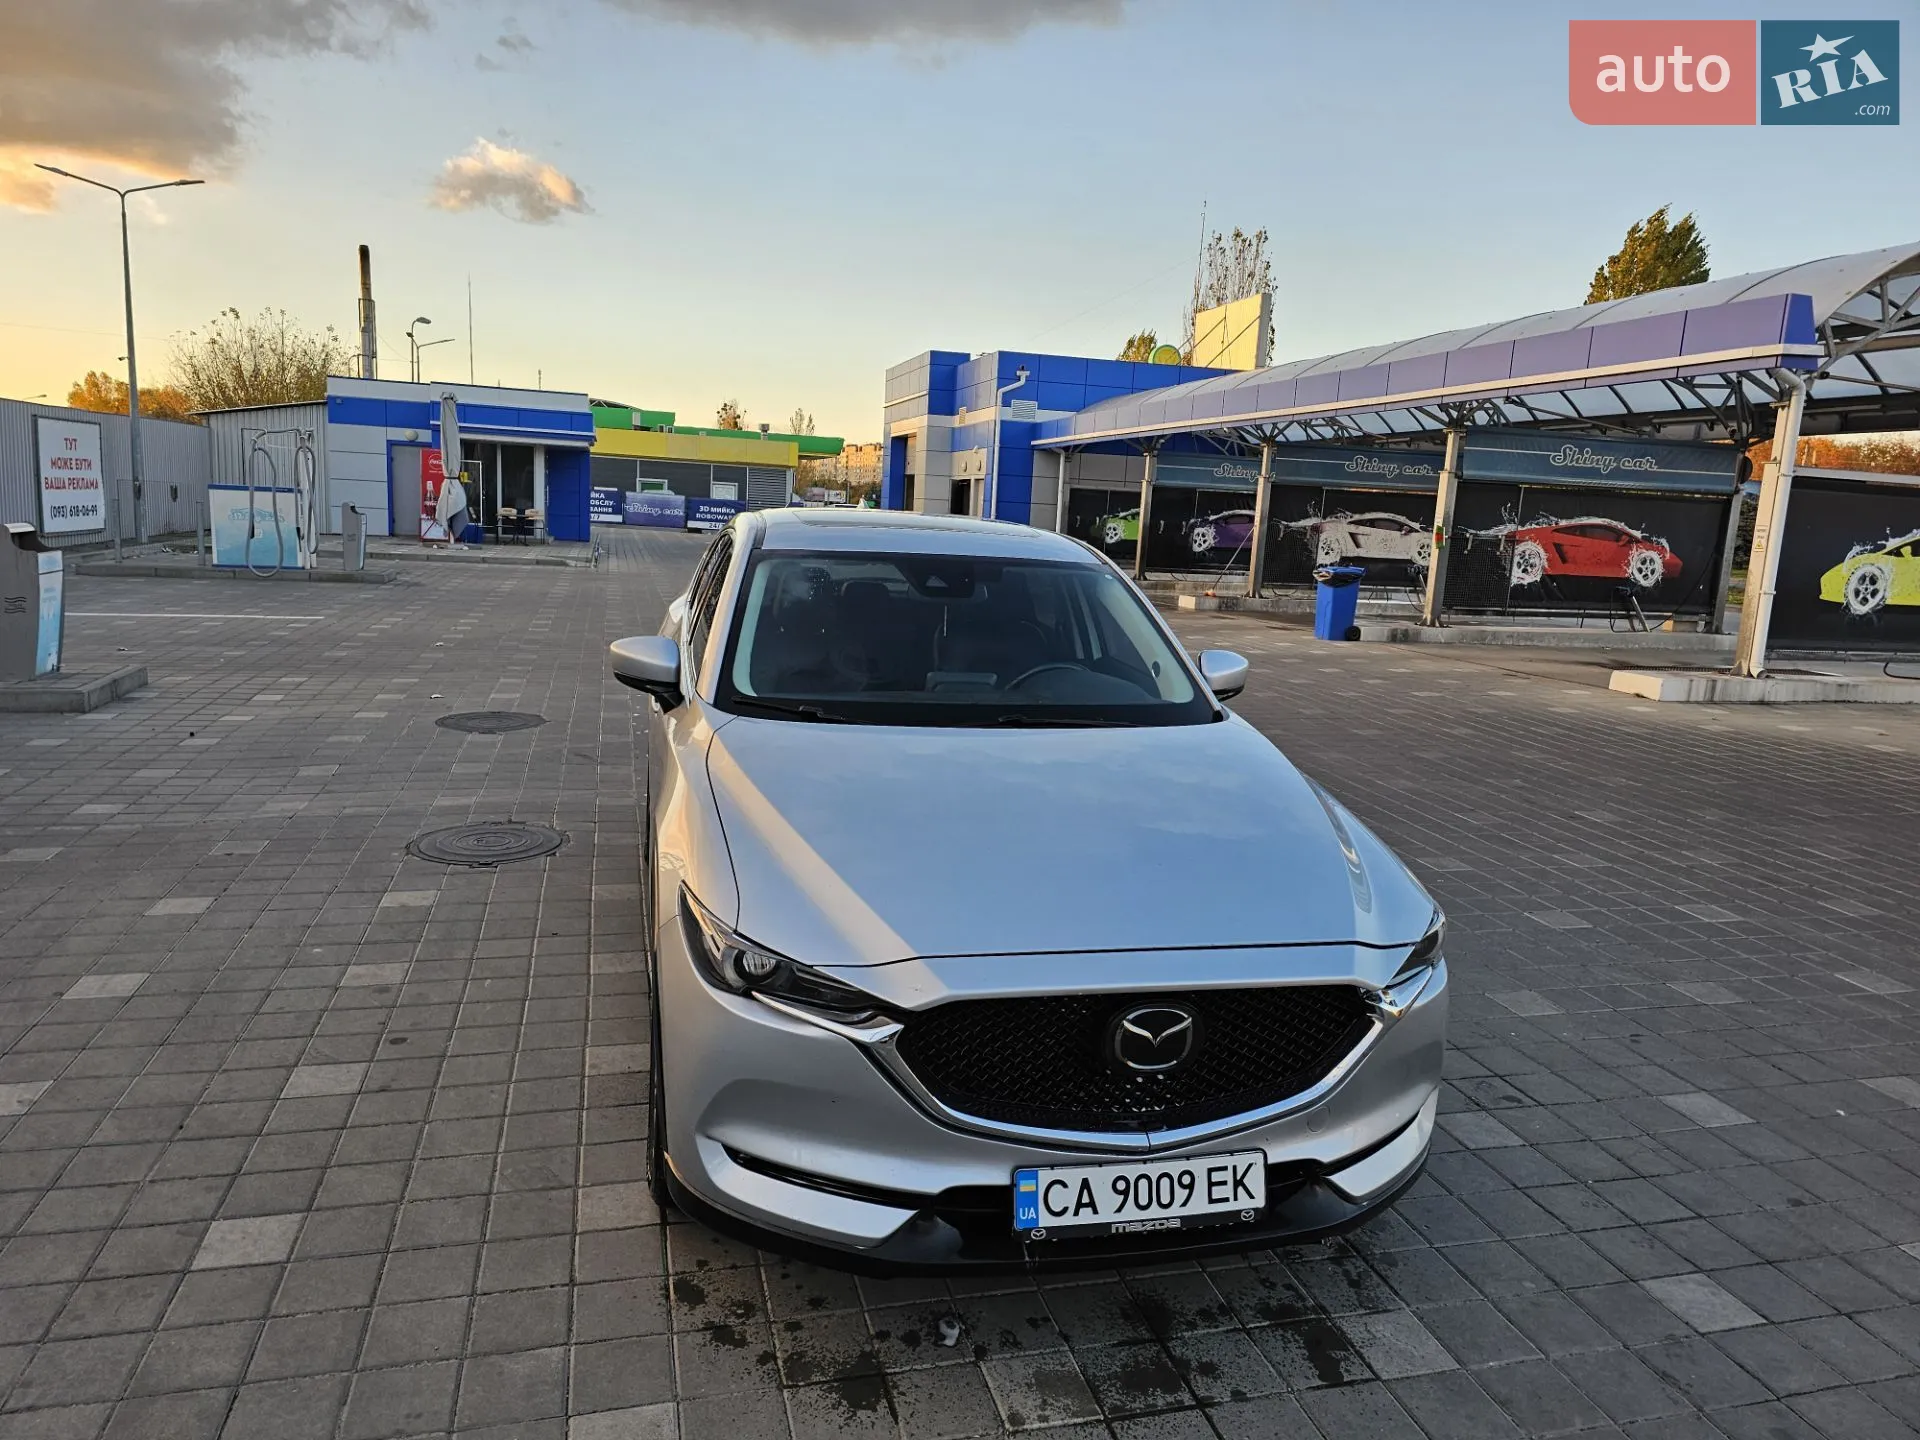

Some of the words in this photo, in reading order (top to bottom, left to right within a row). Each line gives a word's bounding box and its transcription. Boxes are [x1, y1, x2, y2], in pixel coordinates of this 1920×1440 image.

[64, 437, 78, 451] ТУТ
[50, 457, 73, 470] МОЖЕ
[75, 458, 92, 470] БУТИ
[1550, 444, 1618, 473] Shiny
[1620, 457, 1659, 470] car
[1213, 462, 1261, 482] Shiny
[1344, 455, 1400, 478] Shiny
[1402, 464, 1434, 475] car
[44, 477, 67, 490] ВАША
[67, 477, 99, 490] РЕКЛАМА
[50, 505, 68, 519] (093)
[1043, 1177, 1099, 1217] CA
[1111, 1169, 1196, 1214] 9009
[1207, 1162, 1256, 1205] EK
[1019, 1207, 1037, 1220] UA
